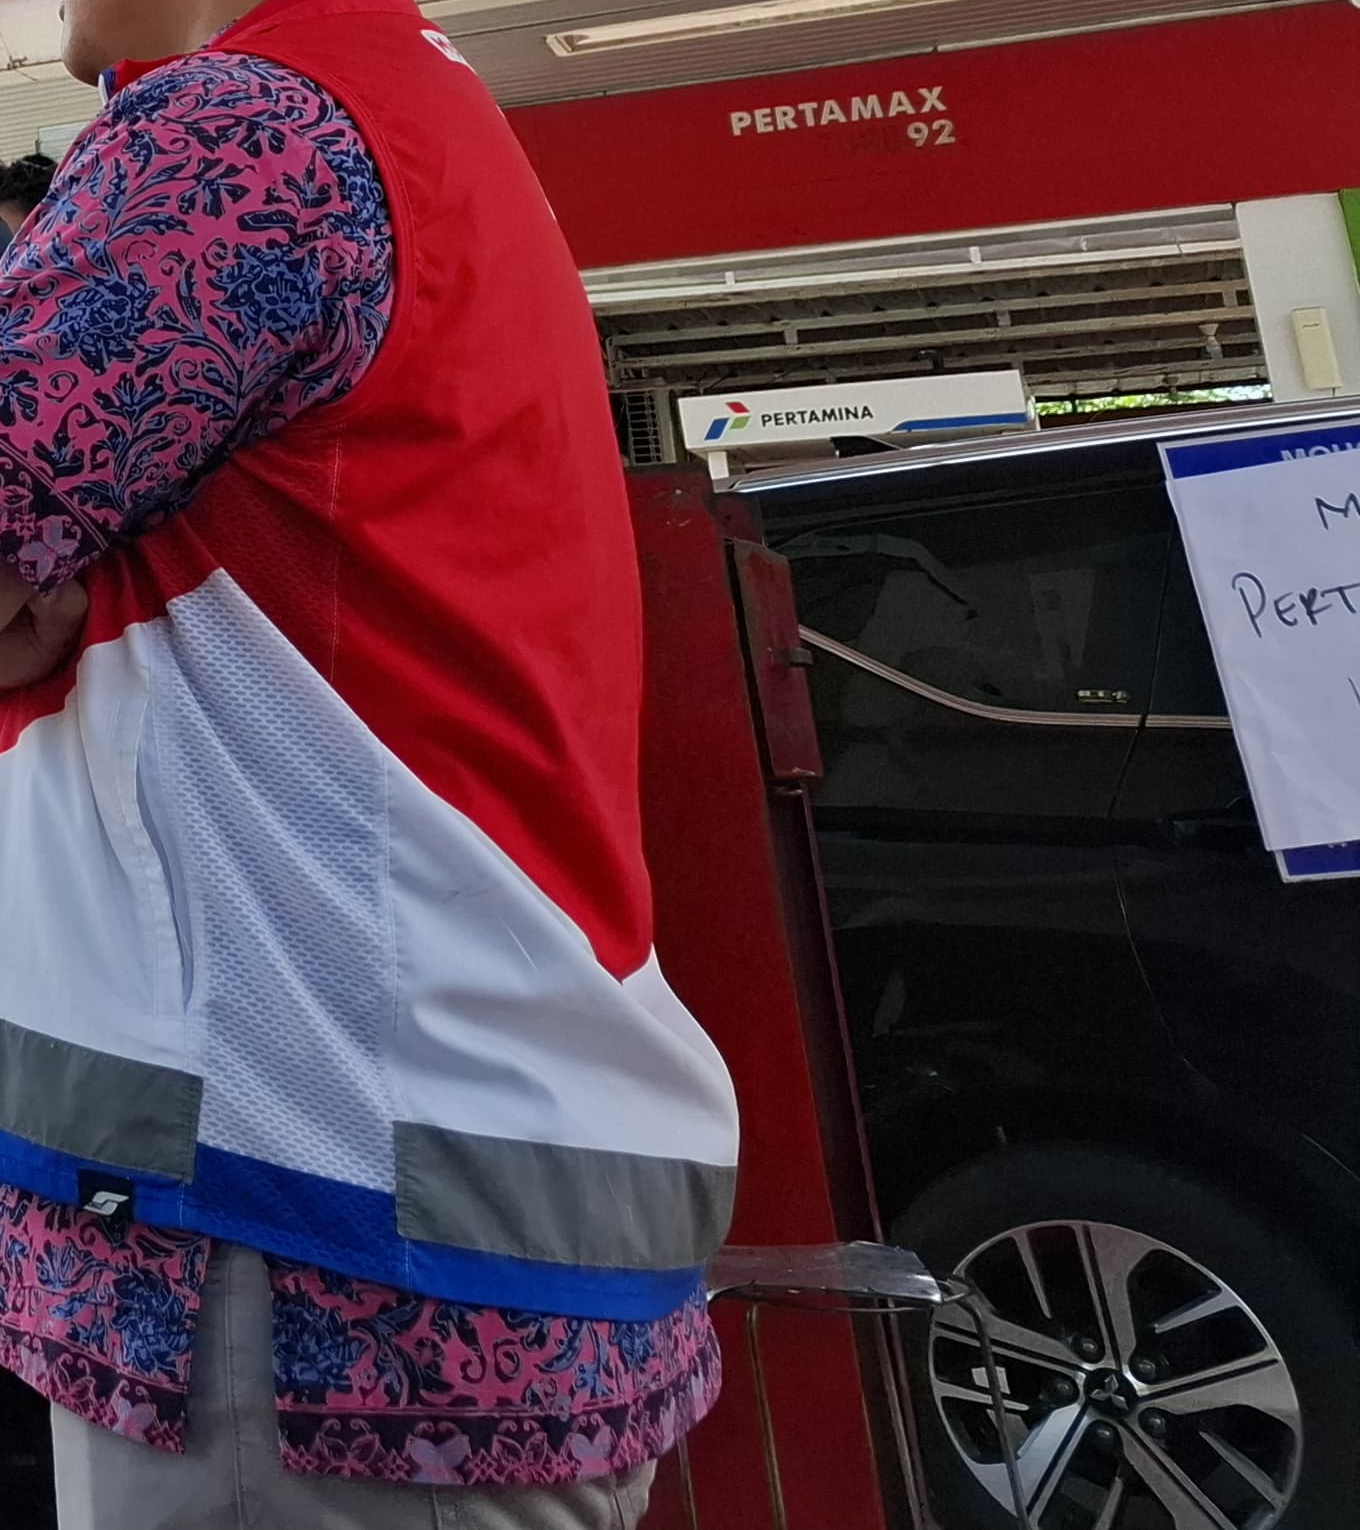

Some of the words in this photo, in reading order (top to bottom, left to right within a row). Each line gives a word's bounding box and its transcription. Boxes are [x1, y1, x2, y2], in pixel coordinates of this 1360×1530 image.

[730, 86, 948, 137] PERTAMAX
[906, 119, 957, 148] 92
[761, 406, 873, 427] PERTAMINA
